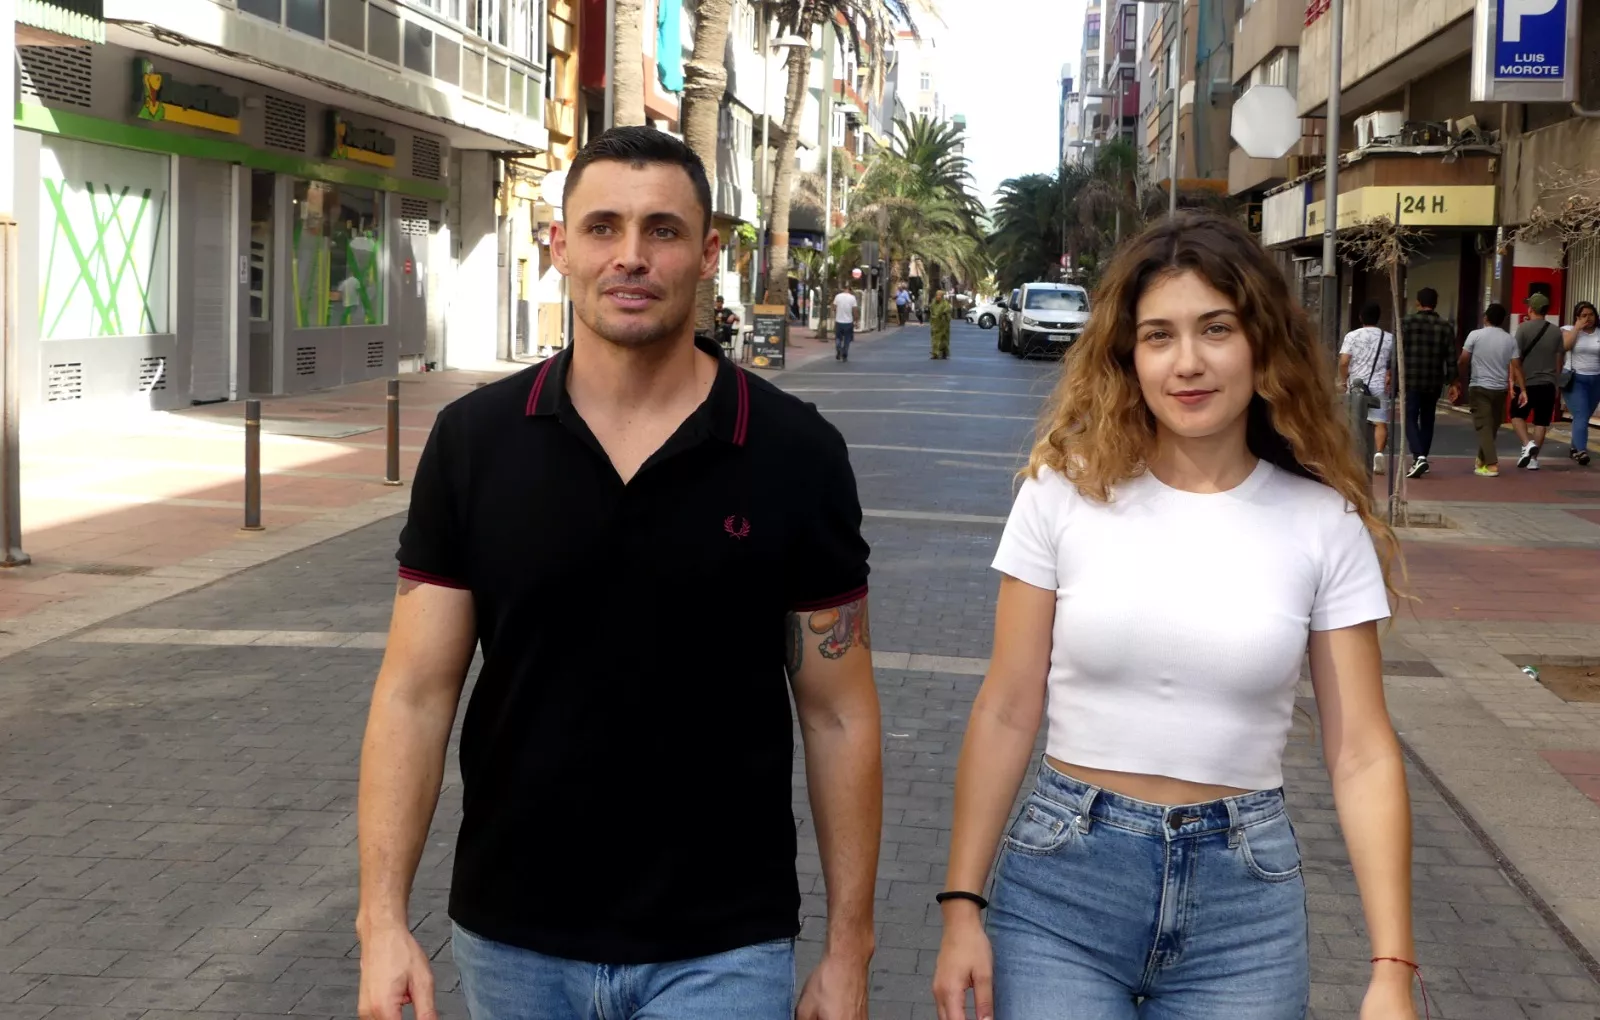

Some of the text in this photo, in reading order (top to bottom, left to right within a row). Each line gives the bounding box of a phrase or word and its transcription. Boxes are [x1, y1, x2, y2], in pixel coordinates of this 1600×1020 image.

[1515, 54, 1545, 62] LUIS
[1500, 65, 1559, 74] MOROTE
[1403, 195, 1426, 213] 24
